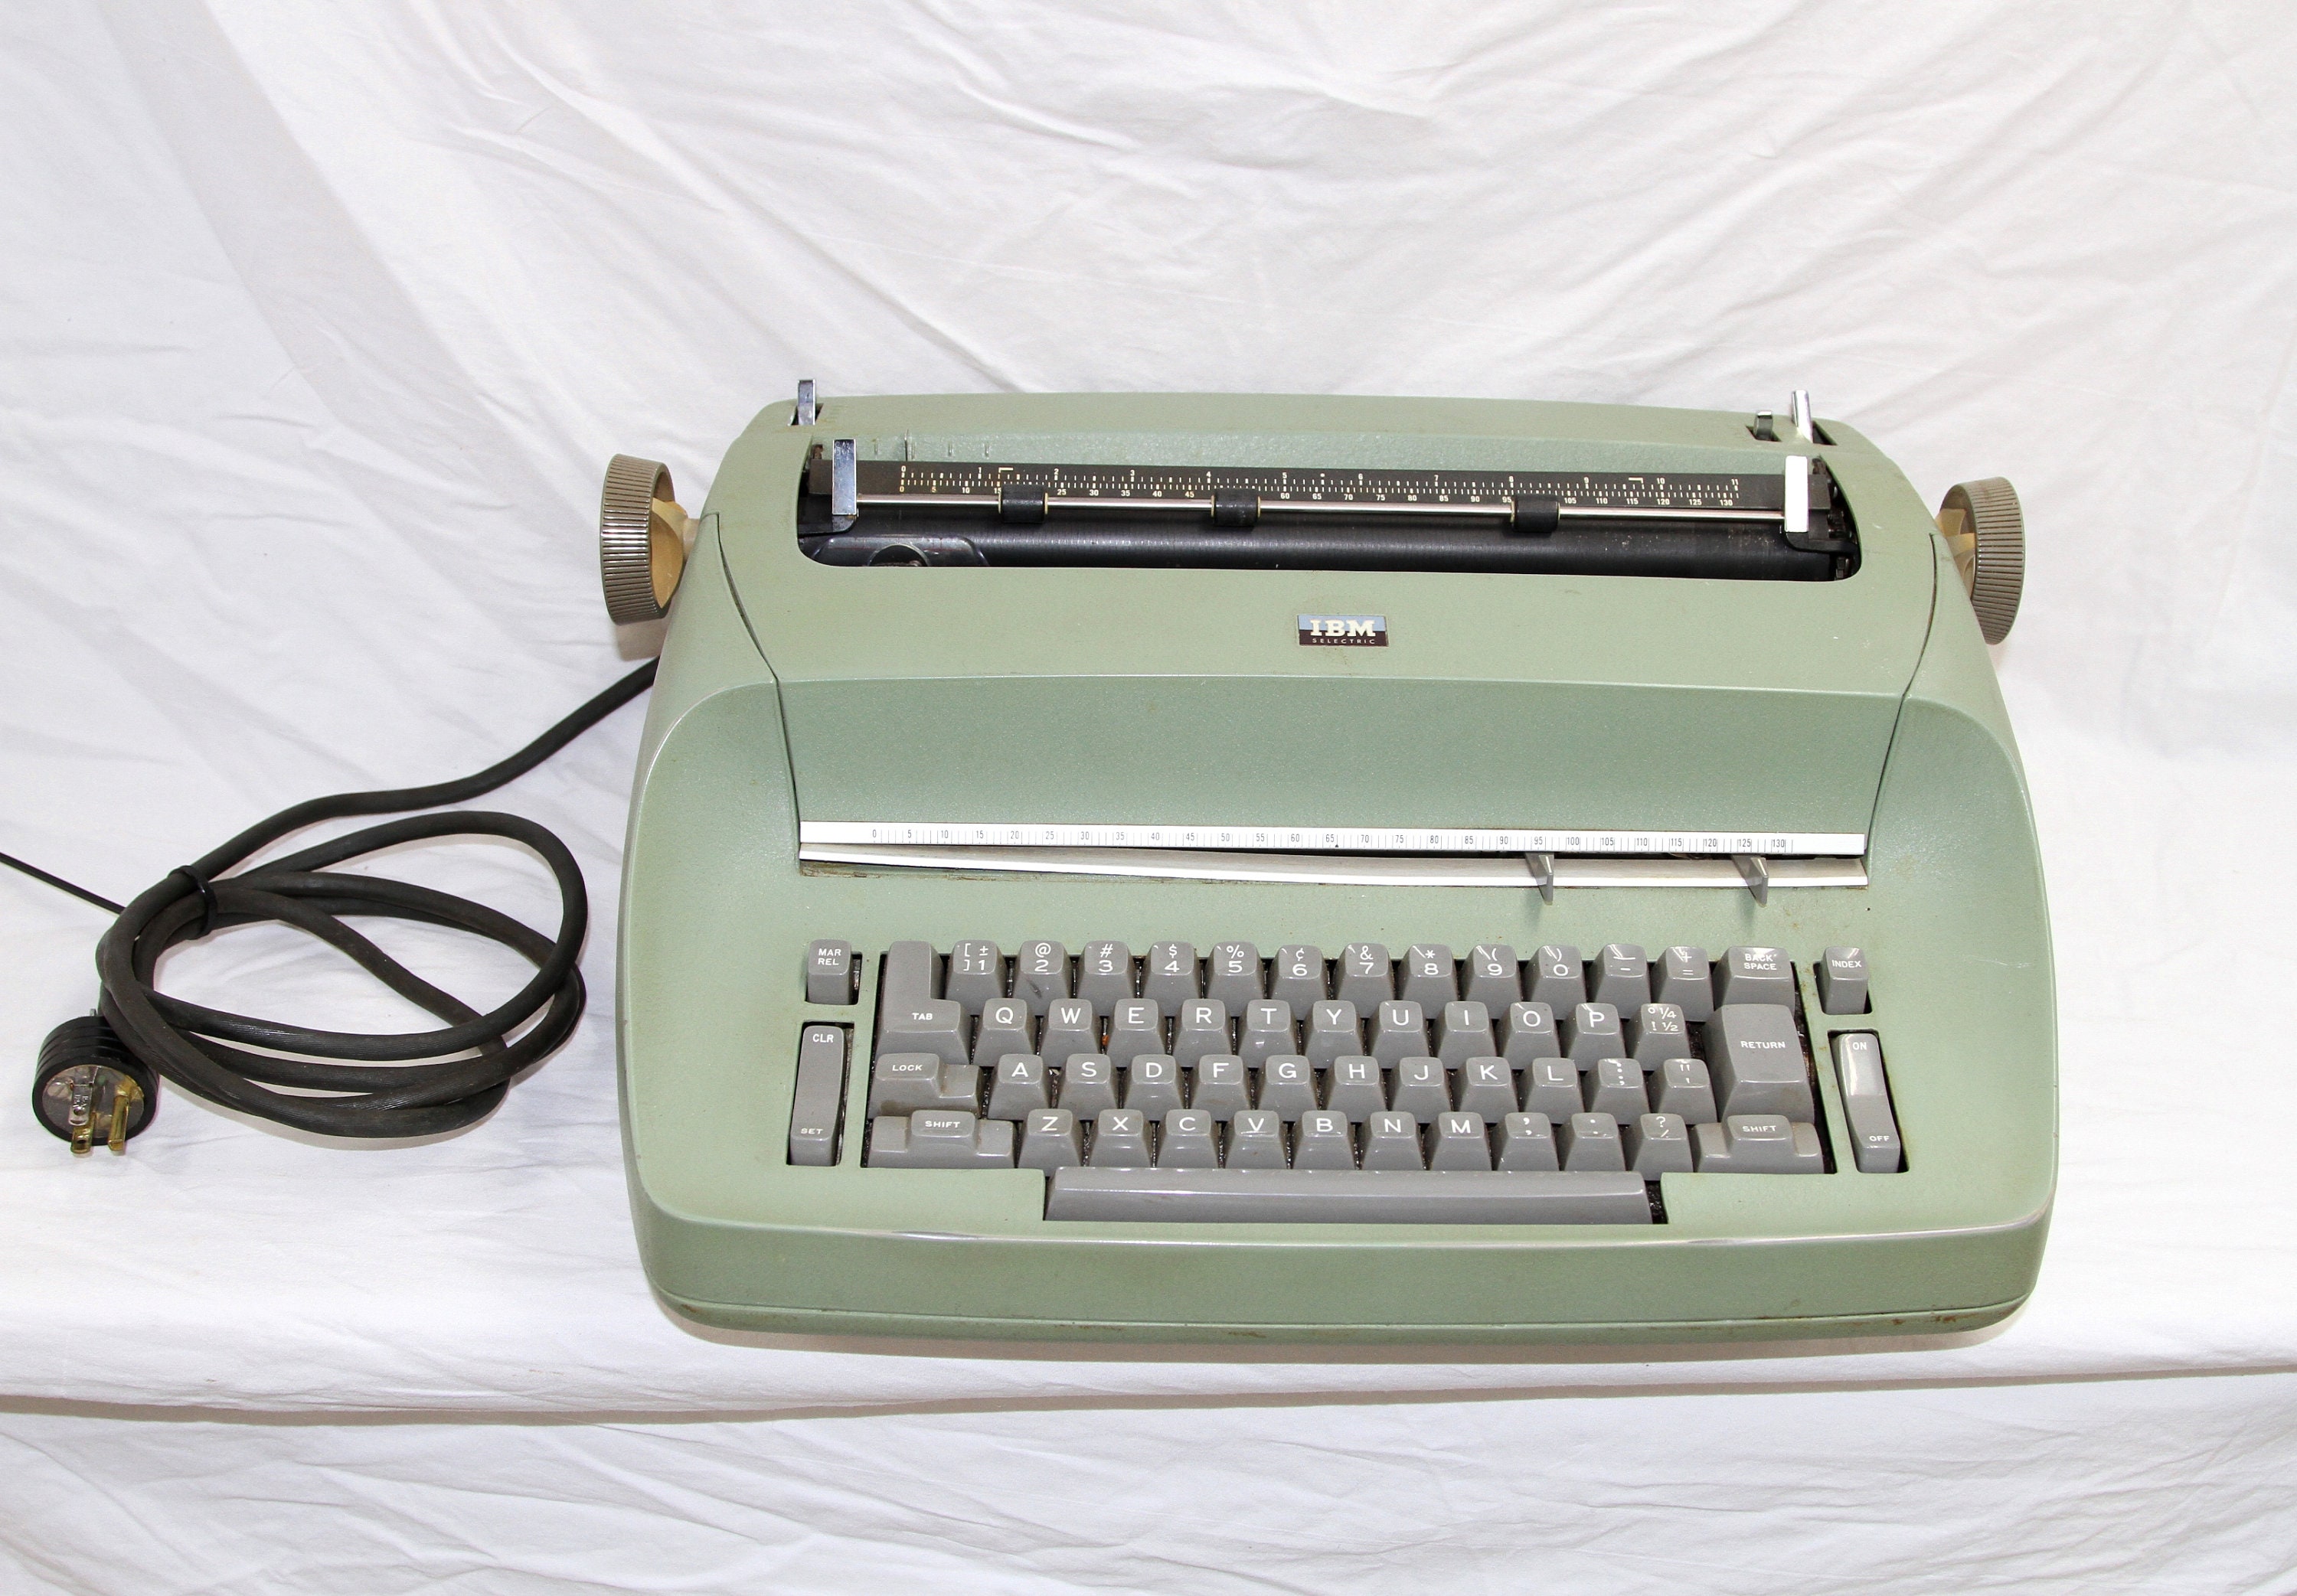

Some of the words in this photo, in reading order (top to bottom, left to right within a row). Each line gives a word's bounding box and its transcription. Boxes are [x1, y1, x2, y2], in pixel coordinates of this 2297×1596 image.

[1310, 618, 1376, 637] IBM
[941, 831, 949, 839] 10
[976, 831, 984, 839] 15
[1011, 831, 1019, 840] 20
[1045, 831, 1054, 840] 25
[1080, 831, 1090, 840] 30
[1116, 832, 1125, 840] 35
[1151, 832, 1160, 840] 40
[1221, 833, 1230, 841] 50
[1256, 833, 1265, 842] 55
[1291, 834, 1300, 842] 60
[1325, 834, 1335, 843] 65
[1361, 835, 1369, 844] 70
[1396, 835, 1404, 844] 75
[1429, 835, 1439, 844] 80
[1465, 836, 1474, 844] 85
[1499, 836, 1508, 844] 90
[1534, 837, 1543, 845] 95
[1567, 837, 1580, 846] 100
[1602, 837, 1614, 846] 105
[1636, 838, 1648, 847] 110
[1671, 838, 1682, 847] 115
[1705, 838, 1717, 847] 120
[1739, 838, 1751, 847] 125
[1773, 839, 1785, 848] 130
[818, 948, 841, 957] MAR
[1034, 942, 1051, 958] @
[1099, 943, 1113, 958] #
[1168, 944, 1178, 958] $
[1226, 945, 1245, 958] %
[1359, 945, 1374, 961] &
[1744, 953, 1773, 962] BACK
[818, 958, 839, 966] REL
[979, 960, 985, 971] 1
[1034, 960, 1049, 972] 2
[1098, 960, 1113, 972] 3
[1164, 960, 1180, 973] 4
[1228, 960, 1243, 973] 5
[1358, 961, 1374, 974] 7
[1423, 964, 1439, 975] 8
[1487, 963, 1503, 976] 9
[1743, 962, 1777, 971] SPACE
[1831, 960, 1862, 968] INDEX
[1292, 964, 1308, 977] 6
[1553, 964, 1569, 977] 0
[995, 1007, 1014, 1025] Q
[1060, 1007, 1081, 1023] W
[1128, 1007, 1145, 1023] E
[1195, 1007, 1212, 1023] R
[1260, 1008, 1277, 1024] T
[1326, 1008, 1342, 1025] Y
[1392, 1009, 1409, 1026] U
[1522, 1010, 1541, 1026] O
[1588, 1011, 1605, 1027] P
[812, 1033, 834, 1043] CLR
[1740, 1041, 1786, 1049] RETURN
[1852, 1042, 1867, 1050] ON
[1011, 1062, 1029, 1077] A
[1080, 1062, 1097, 1078] S
[1145, 1062, 1163, 1078] D
[1213, 1062, 1230, 1078] F
[1278, 1063, 1297, 1079] G
[1348, 1064, 1365, 1079] H
[1413, 1065, 1429, 1081] J
[1480, 1065, 1498, 1080] K
[1547, 1066, 1563, 1081] L
[1041, 1117, 1058, 1131] Z
[1112, 1117, 1129, 1131] X
[1178, 1117, 1196, 1131] C
[1248, 1118, 1265, 1132] V
[1316, 1118, 1334, 1133] B
[1384, 1118, 1401, 1133] N
[1450, 1119, 1471, 1134] M
[1655, 1116, 1666, 1127] ?
